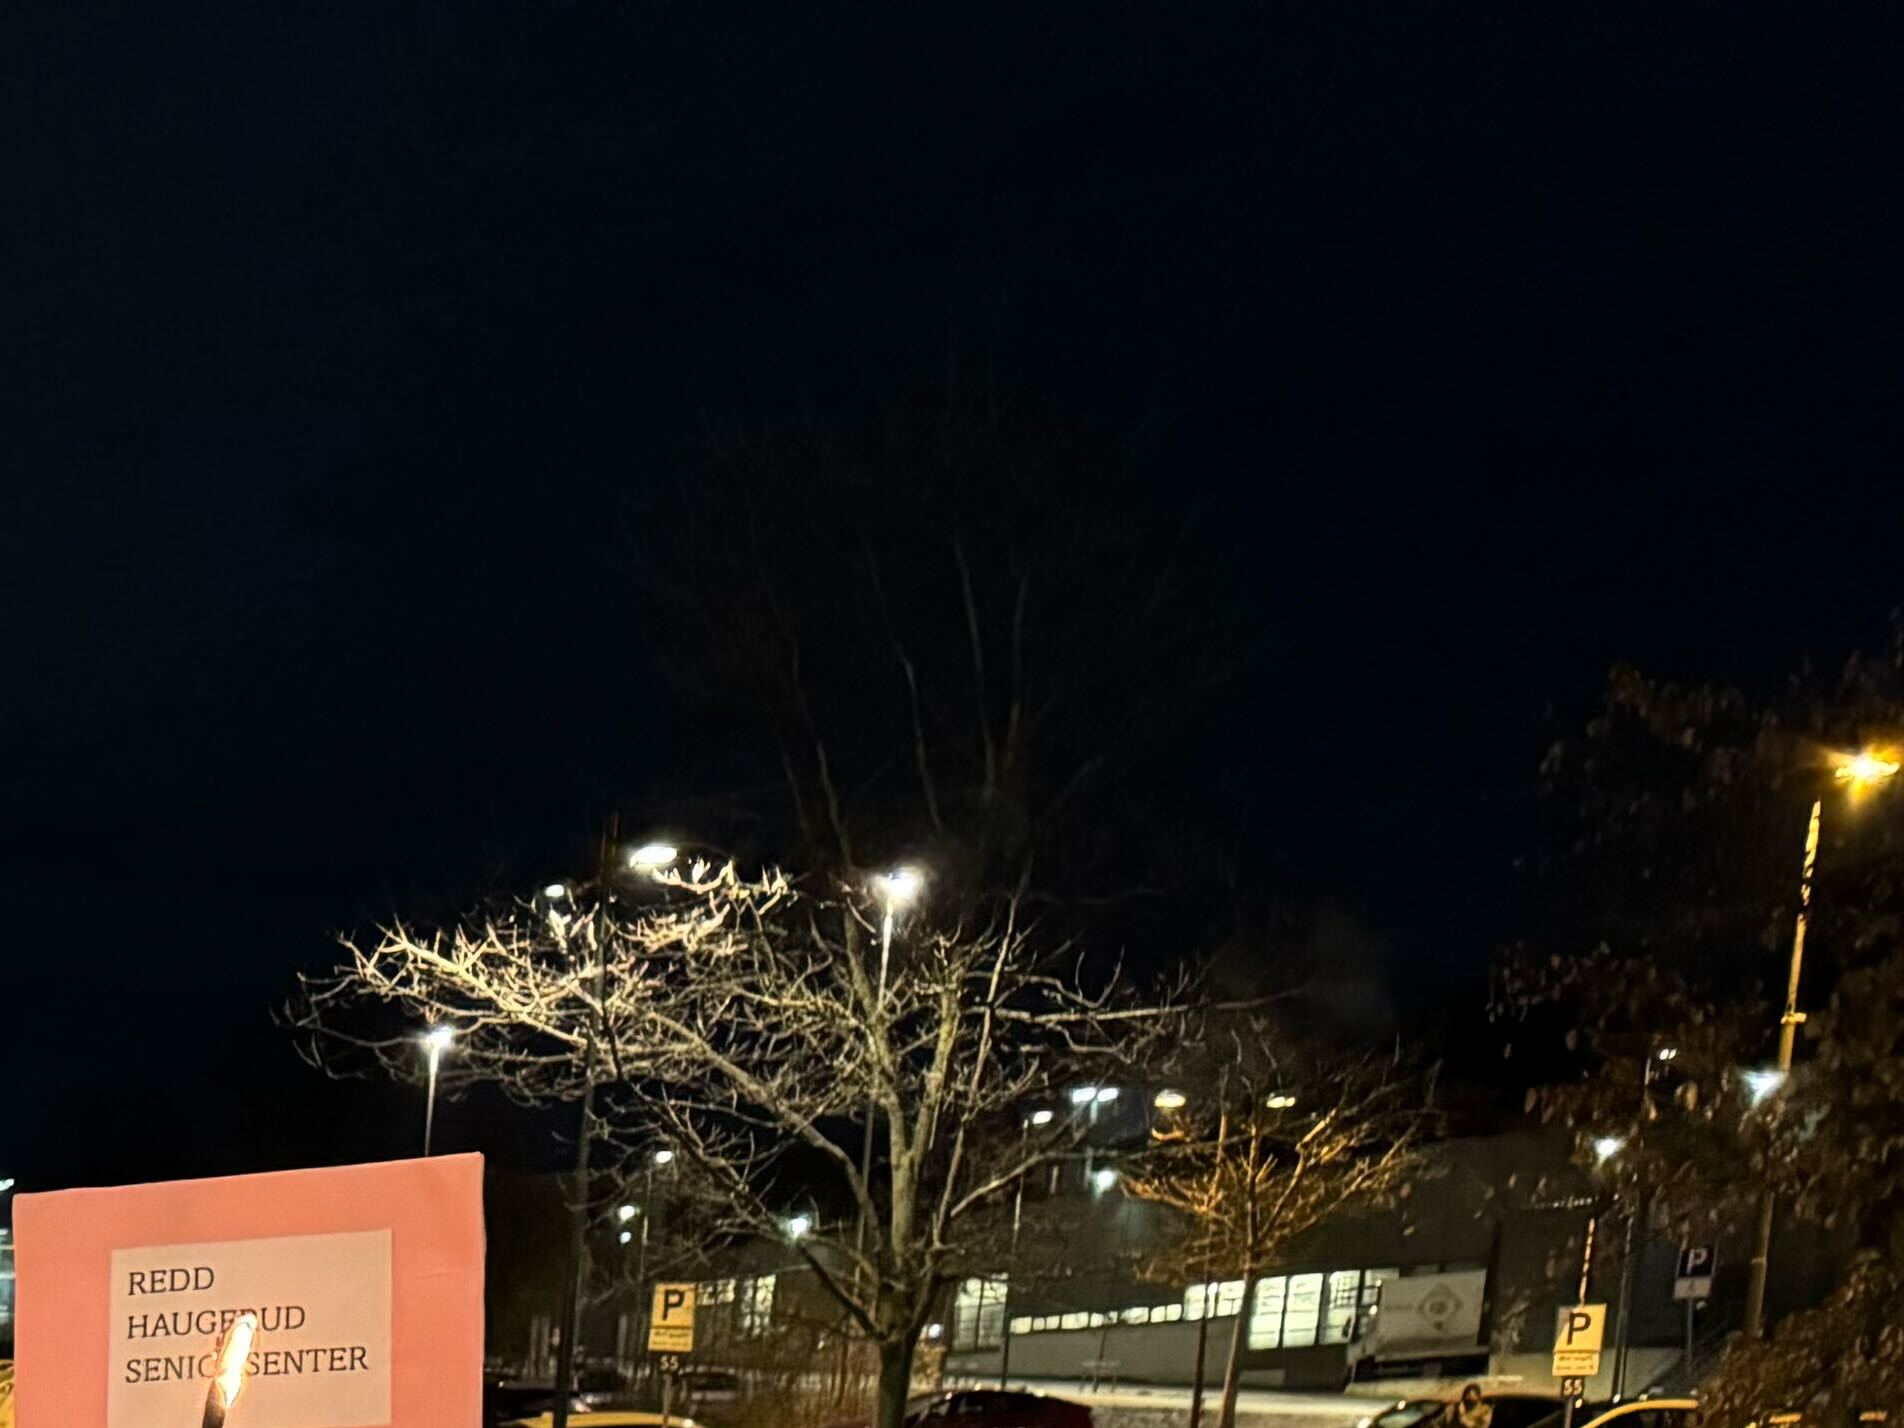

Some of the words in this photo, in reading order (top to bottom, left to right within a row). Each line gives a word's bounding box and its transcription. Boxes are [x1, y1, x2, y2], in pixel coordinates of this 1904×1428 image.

[1686, 1248, 1707, 1275] P
[128, 1267, 215, 1296] REDD
[662, 1289, 685, 1321] P
[127, 1305, 306, 1340] HAUGEUD
[1566, 1312, 1592, 1345] P
[124, 1345, 370, 1384] SENIOSENTER
